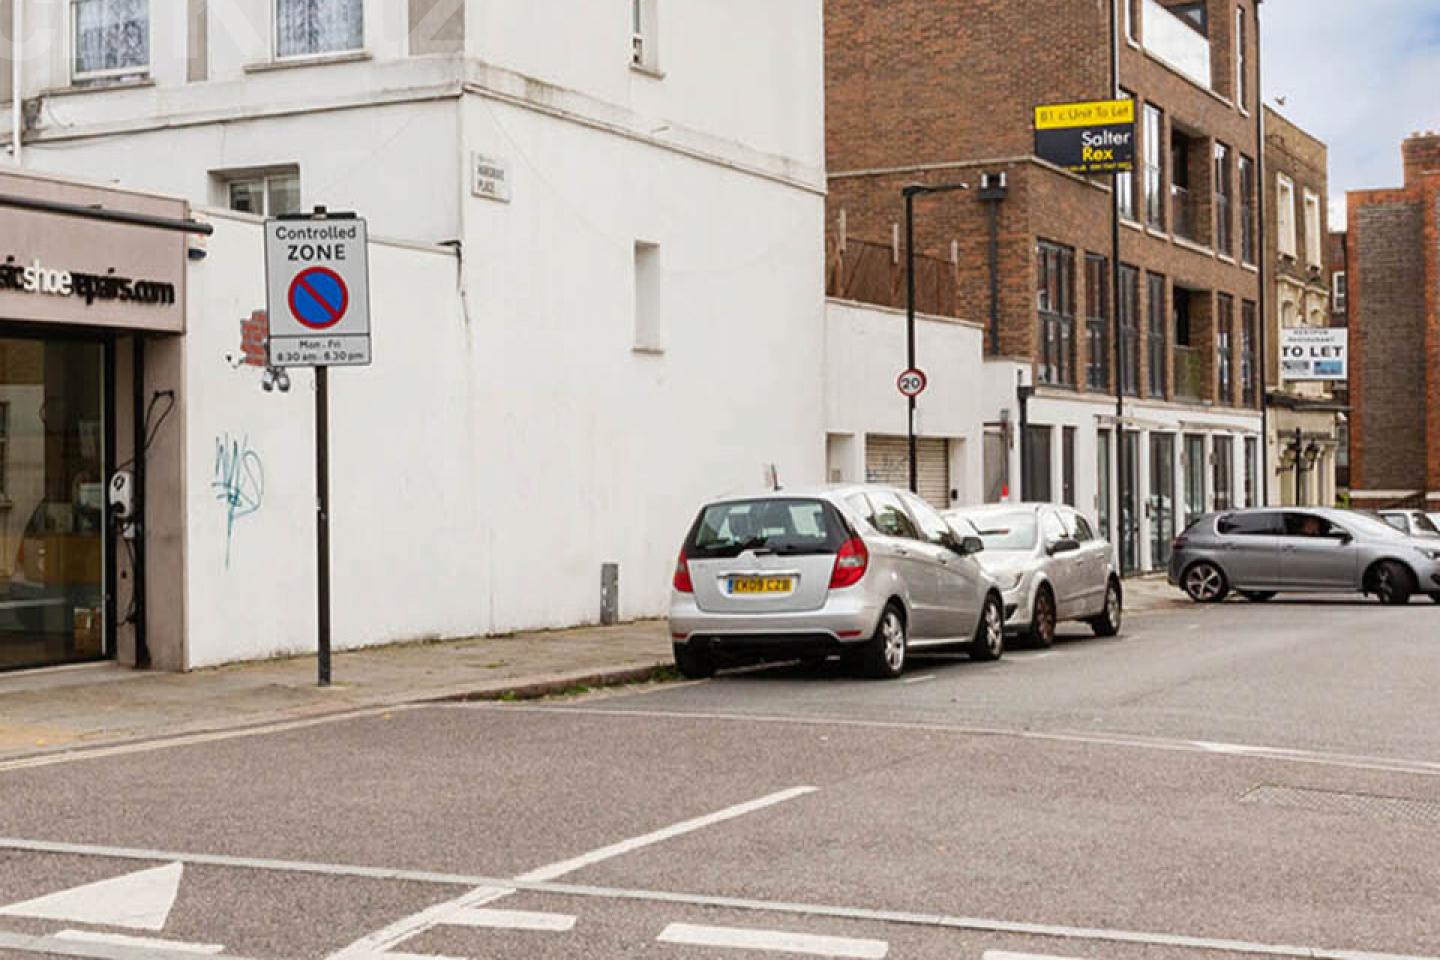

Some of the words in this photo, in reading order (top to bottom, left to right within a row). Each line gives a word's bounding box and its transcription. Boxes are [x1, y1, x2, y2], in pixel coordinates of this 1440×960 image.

[1081, 129, 1131, 146] Salter
[1082, 146, 1113, 161] Rex
[276, 226, 357, 240] Controlled
[287, 243, 347, 261] ZONE
[300, 340, 321, 349] Mon
[328, 339, 341, 348] Fri
[1283, 345, 1304, 358] TO
[1310, 345, 1344, 358] LET
[901, 377, 920, 390] 20
